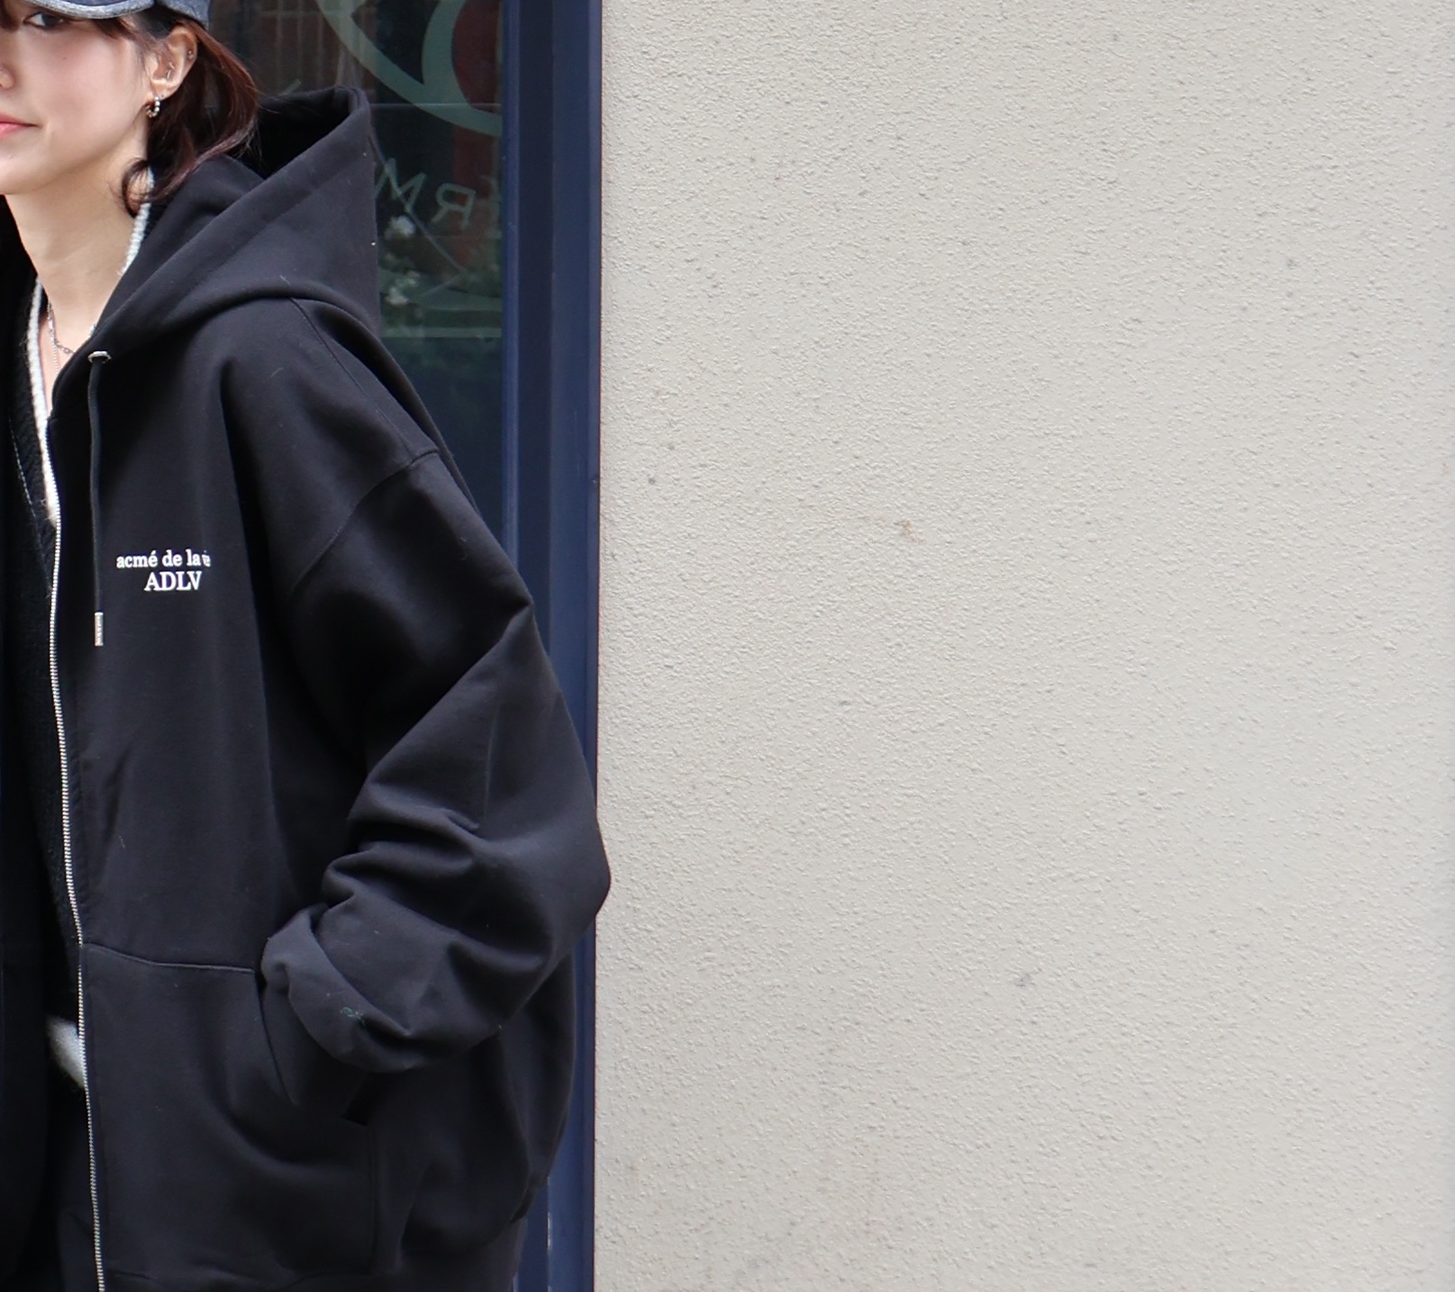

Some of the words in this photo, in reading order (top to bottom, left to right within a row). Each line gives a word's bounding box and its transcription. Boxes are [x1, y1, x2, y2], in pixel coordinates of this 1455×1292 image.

[116, 550, 158, 568] acmé
[162, 549, 183, 567] de
[143, 571, 202, 591] ADLV
